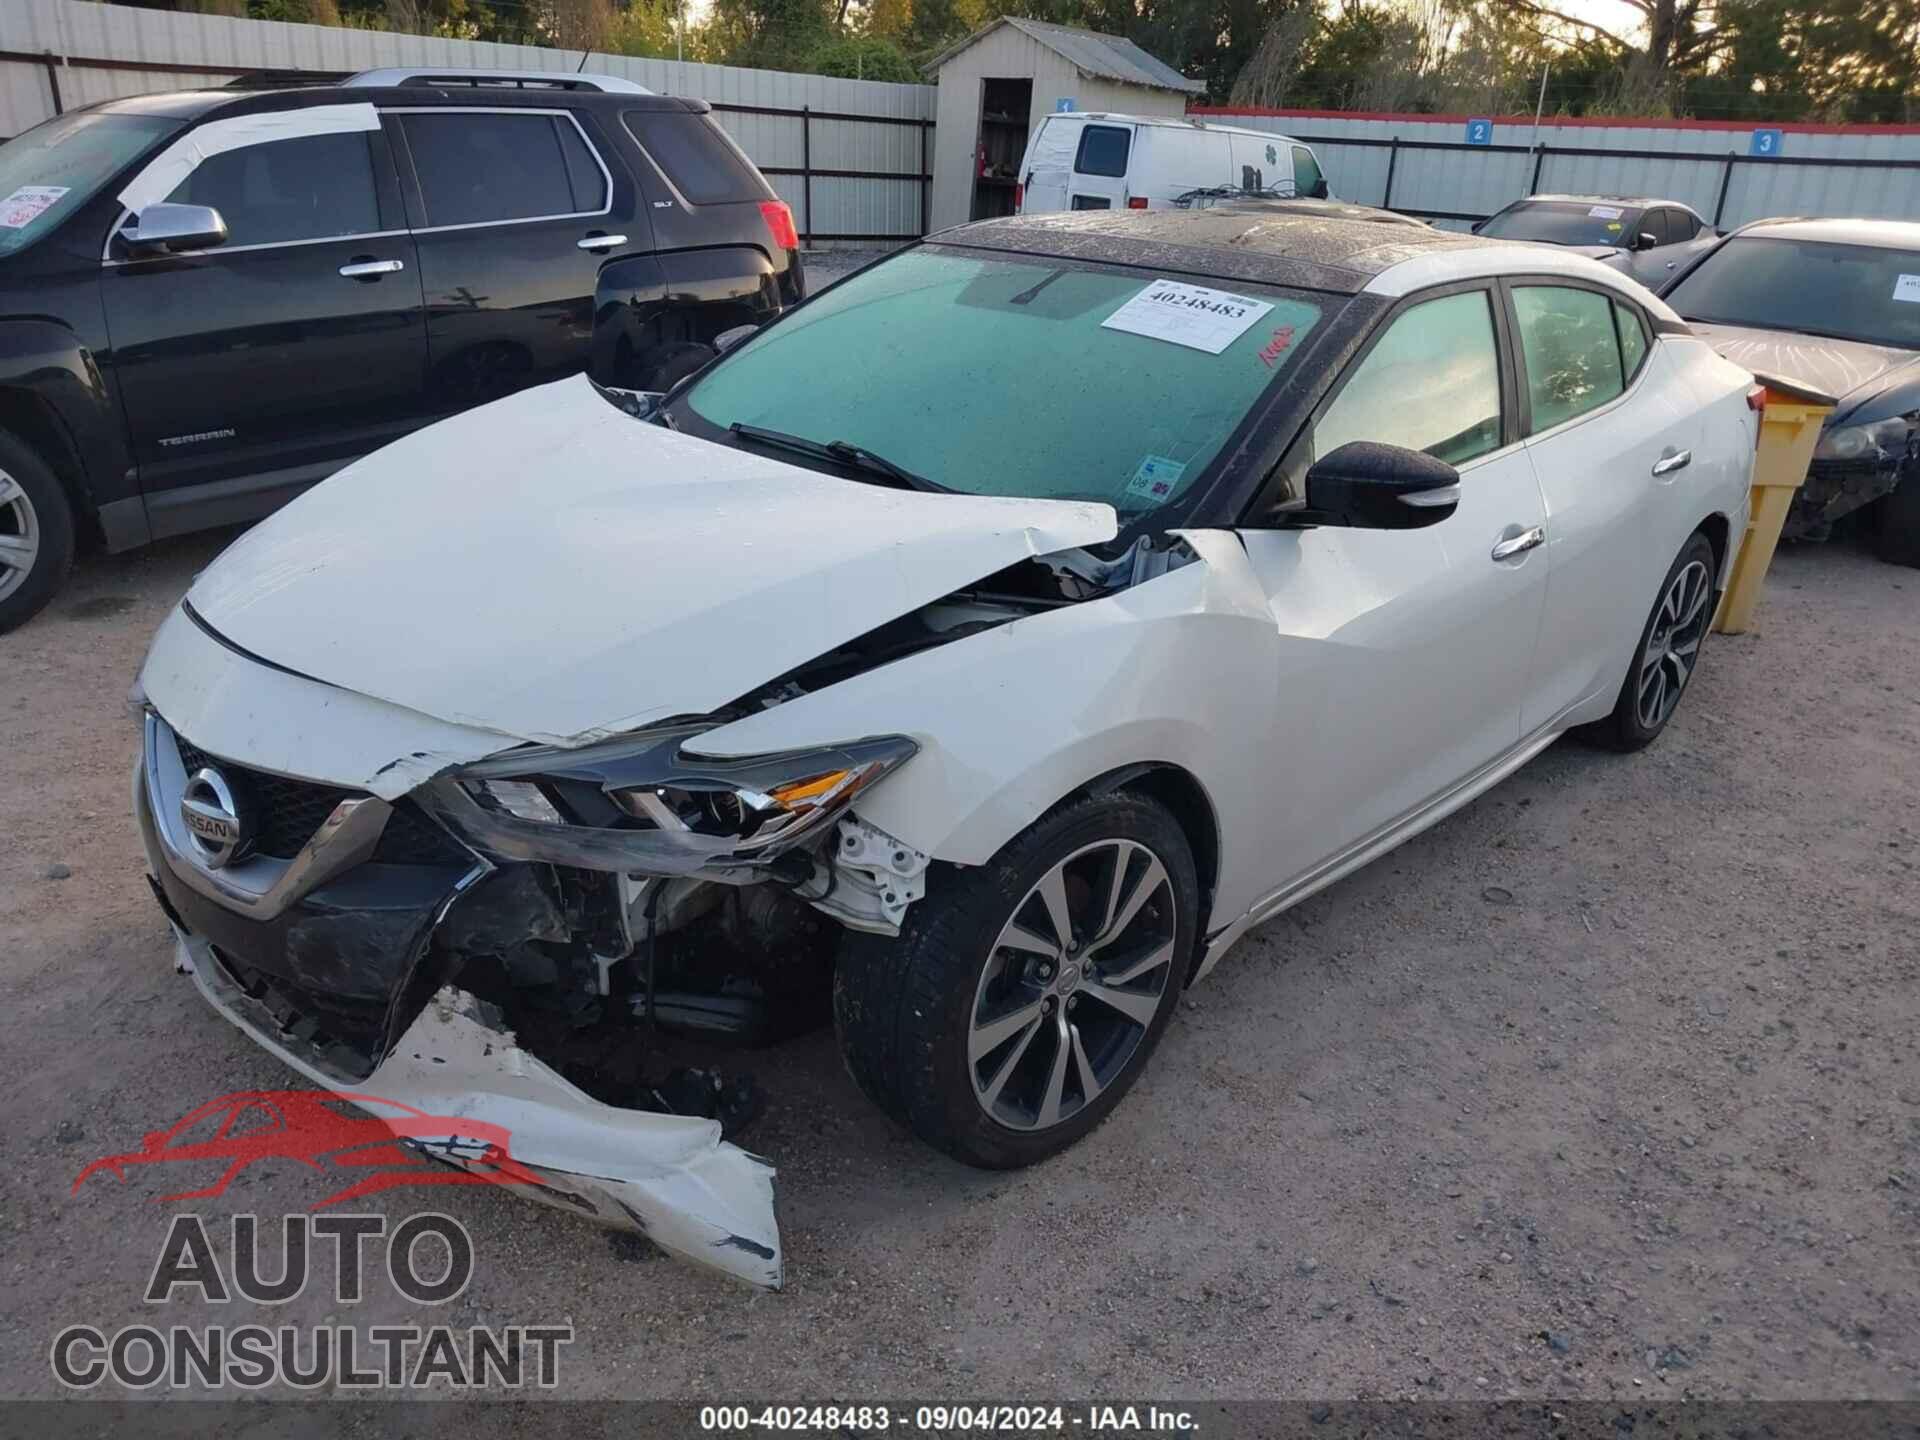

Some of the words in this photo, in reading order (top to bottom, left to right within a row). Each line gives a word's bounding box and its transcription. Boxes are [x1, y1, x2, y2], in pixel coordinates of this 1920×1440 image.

[1474, 124, 1485, 139] 2
[1760, 134, 1772, 152] 3
[1150, 291, 1246, 318] 40248483
[158, 428, 235, 446] TERRAIN
[184, 811, 227, 837] SSAN
